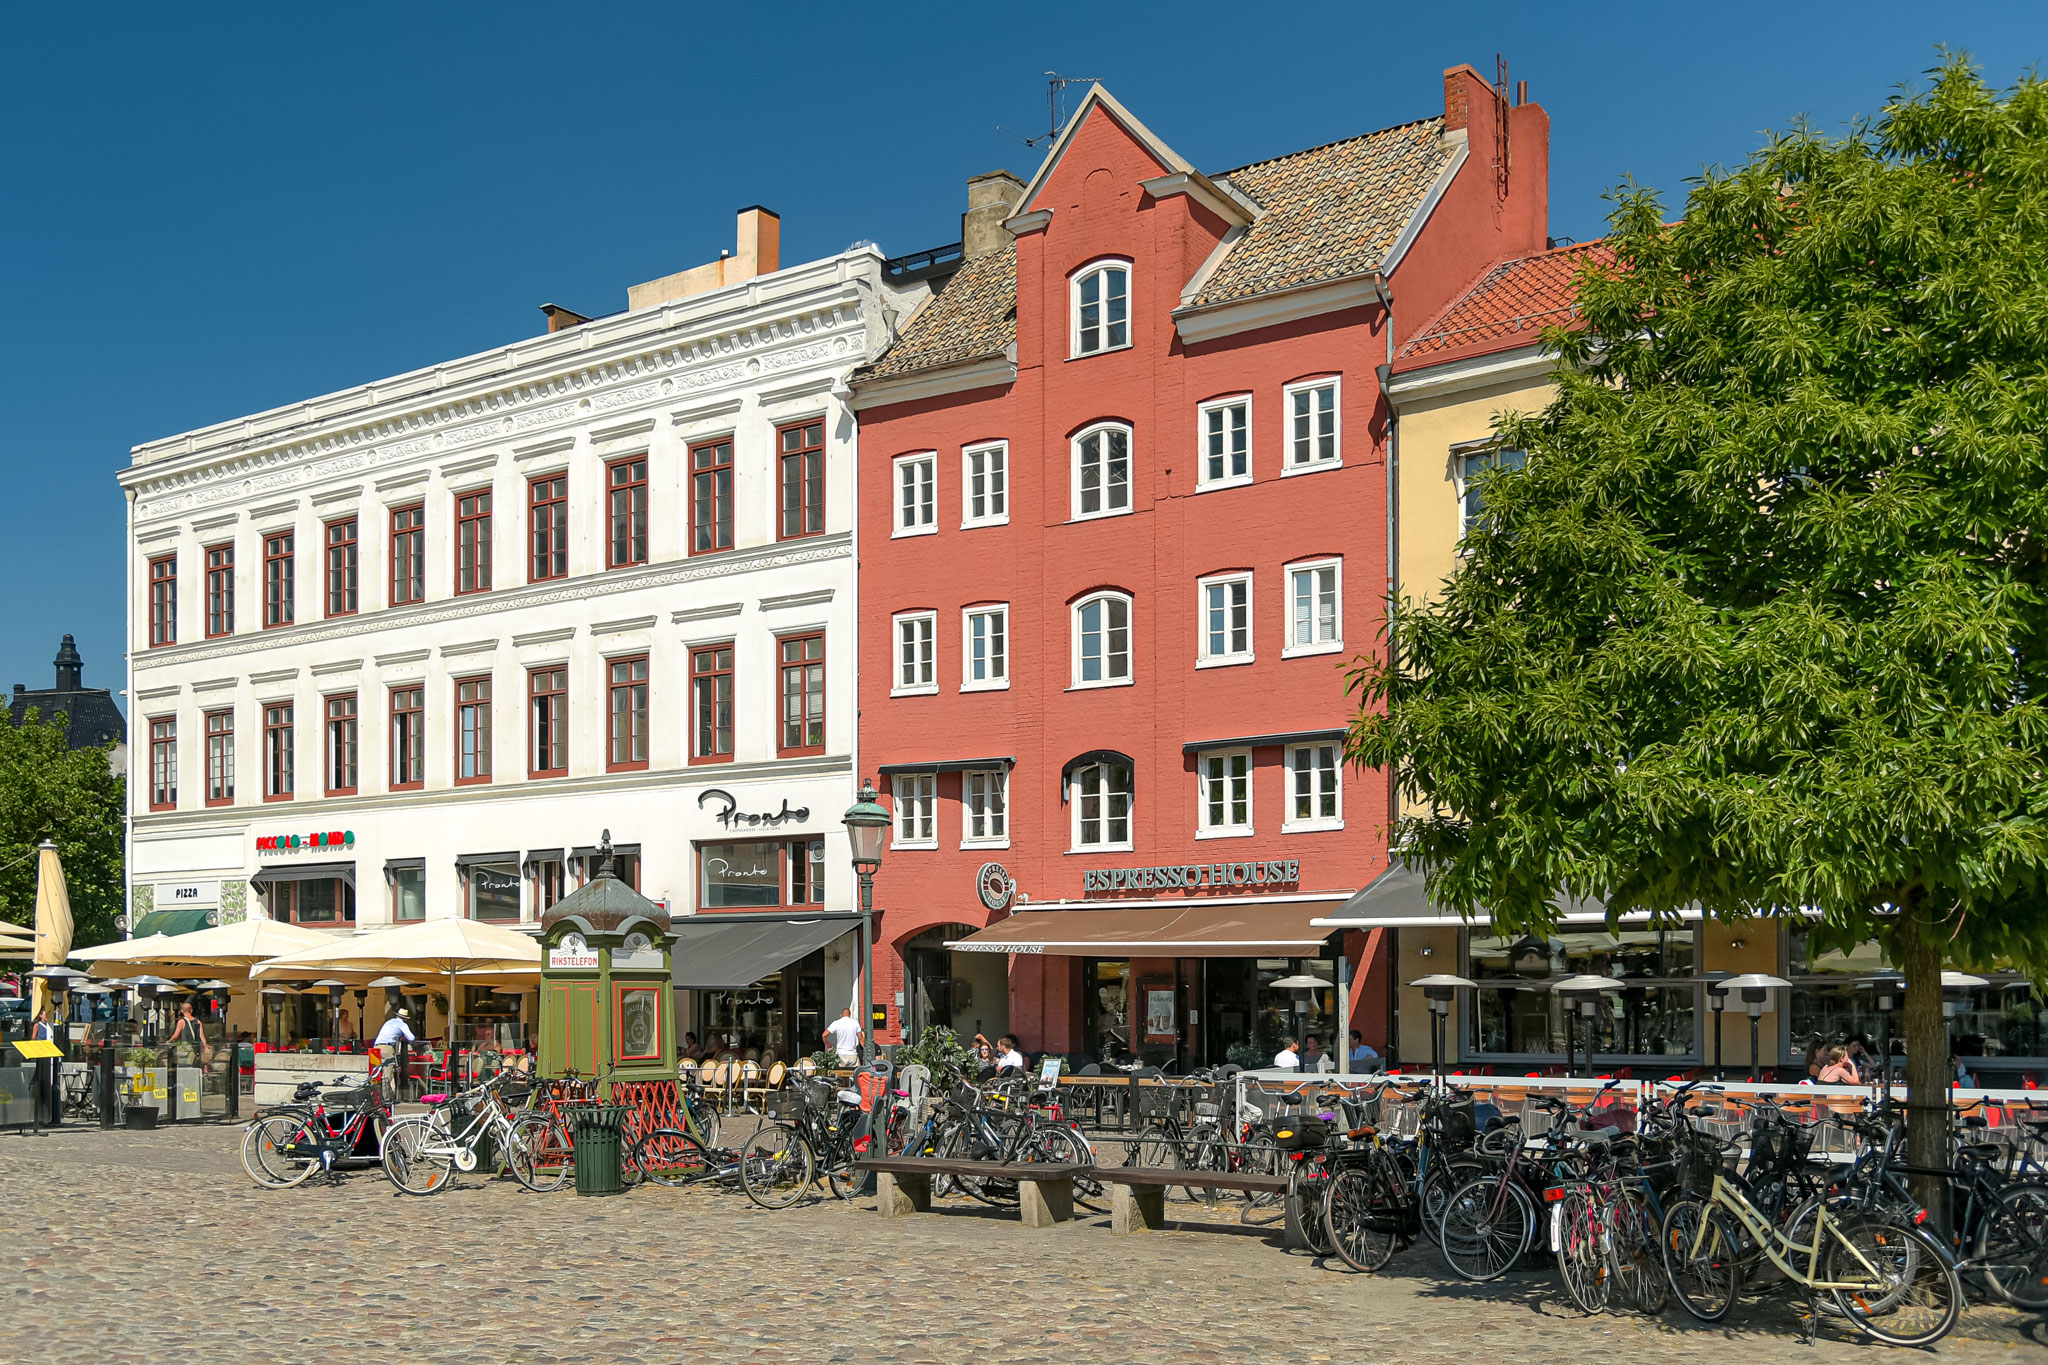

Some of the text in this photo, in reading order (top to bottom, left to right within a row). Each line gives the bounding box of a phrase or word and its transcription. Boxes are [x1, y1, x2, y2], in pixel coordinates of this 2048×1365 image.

[698, 789, 809, 826] Pronto
[256, 834, 301, 850] PICCOLO
[309, 830, 355, 847] MONDO
[707, 857, 768, 878] Pronto
[984, 865, 1008, 884] ESPRESSO
[1083, 859, 1300, 891] ESPRESSO HOUSE
[175, 888, 198, 899] PIZZA
[953, 944, 1045, 953] ESPRESSO HOUSE
[551, 956, 598, 966] RIKSTELEFON
